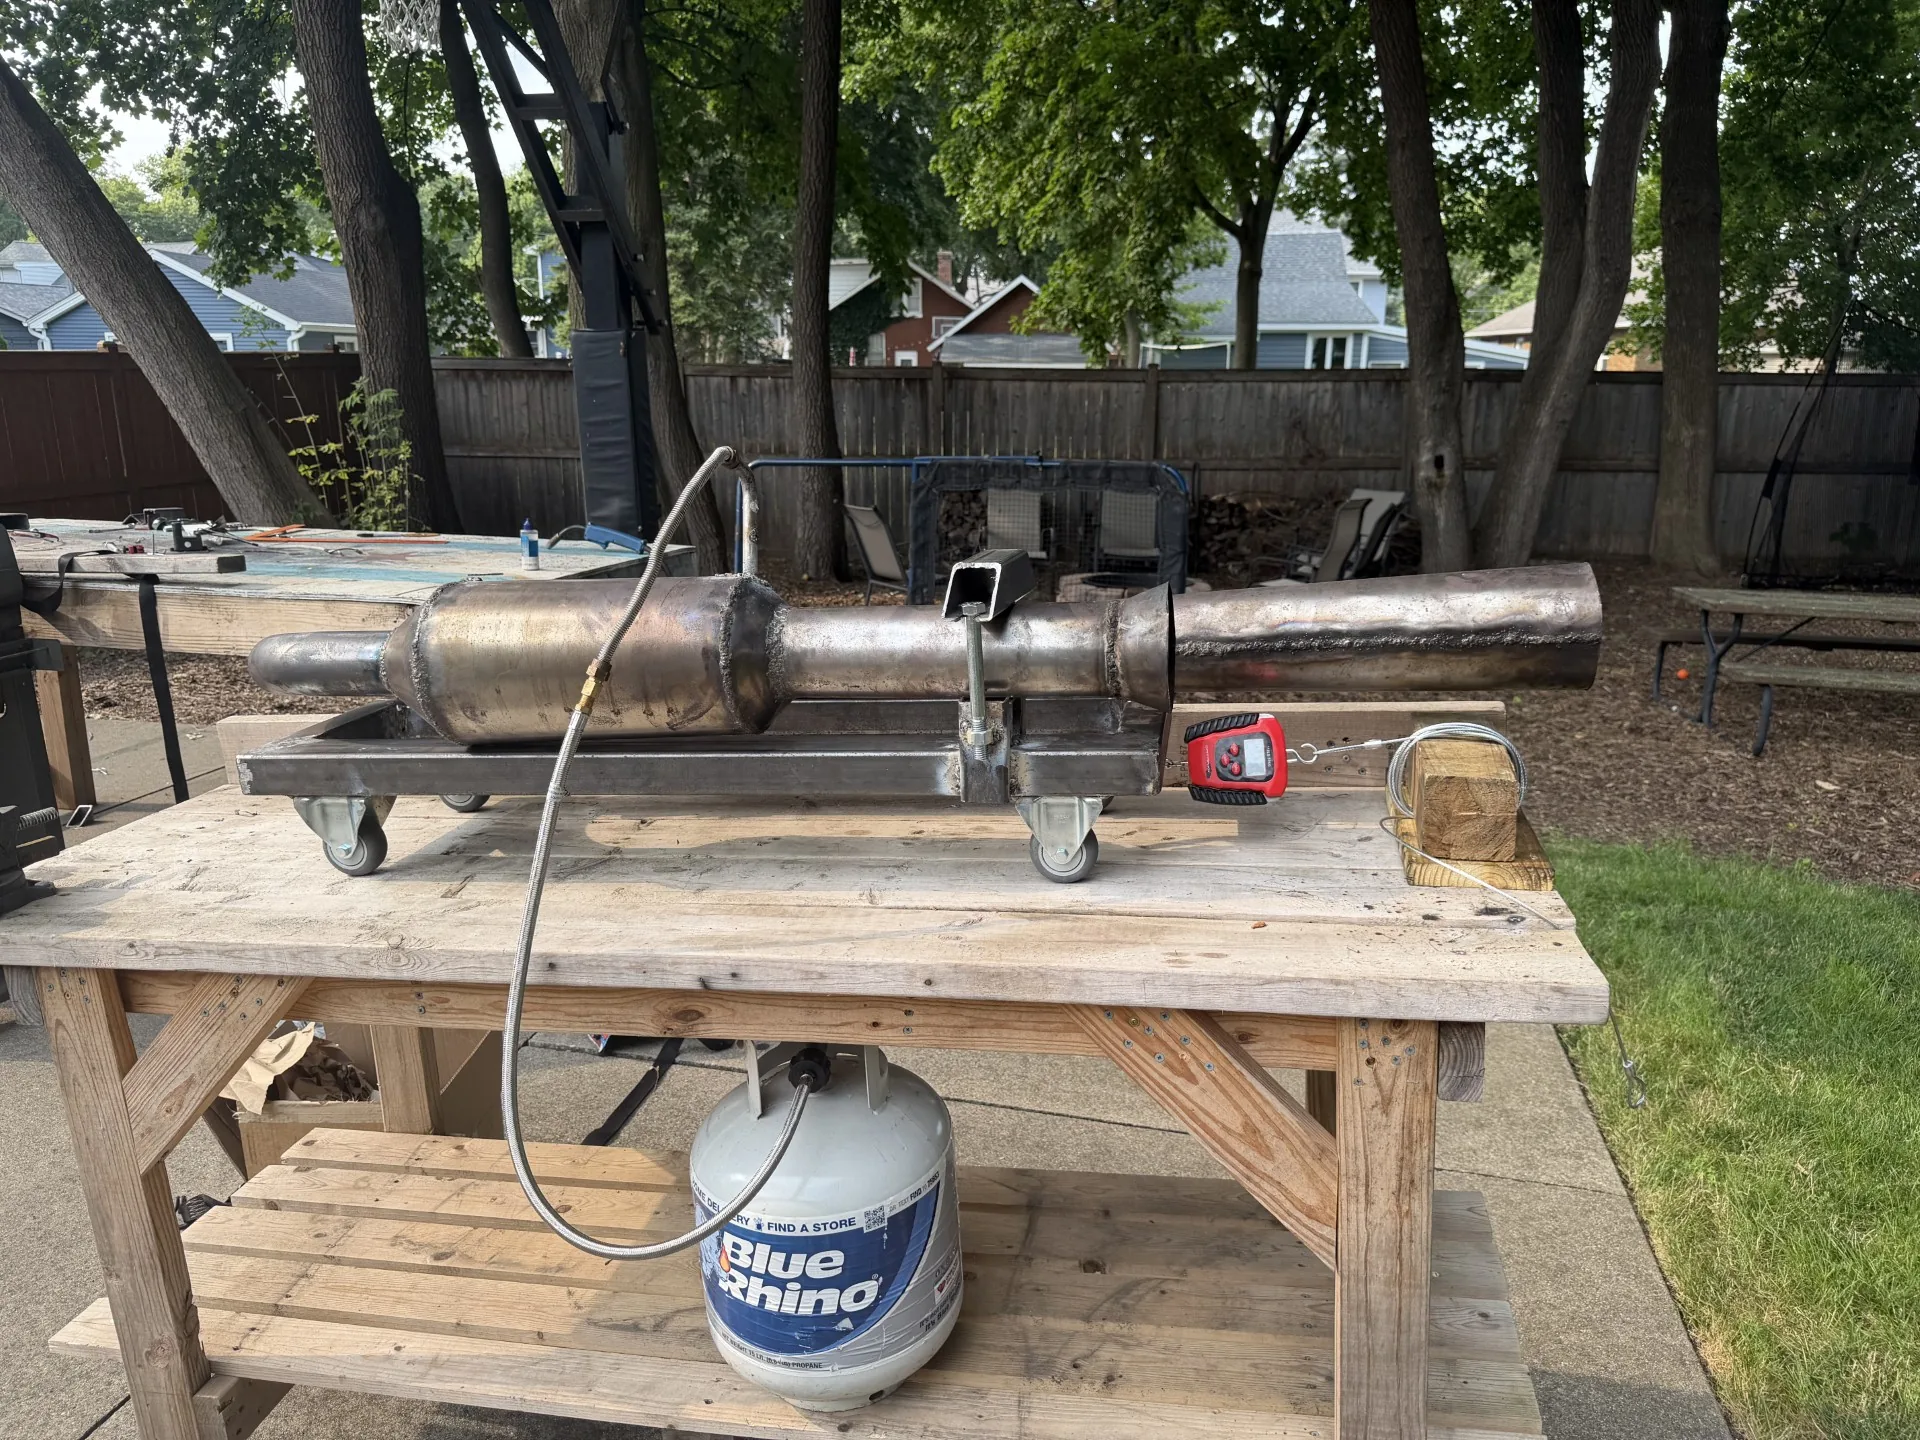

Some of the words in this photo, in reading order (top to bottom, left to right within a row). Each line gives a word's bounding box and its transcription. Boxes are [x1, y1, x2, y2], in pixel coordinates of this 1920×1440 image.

[767, 1221, 795, 1232] FIND
[800, 1224, 809, 1232] A
[813, 1217, 857, 1232] STORE
[723, 1231, 845, 1279] Blue
[791, 1361, 823, 1369] PROPANE
